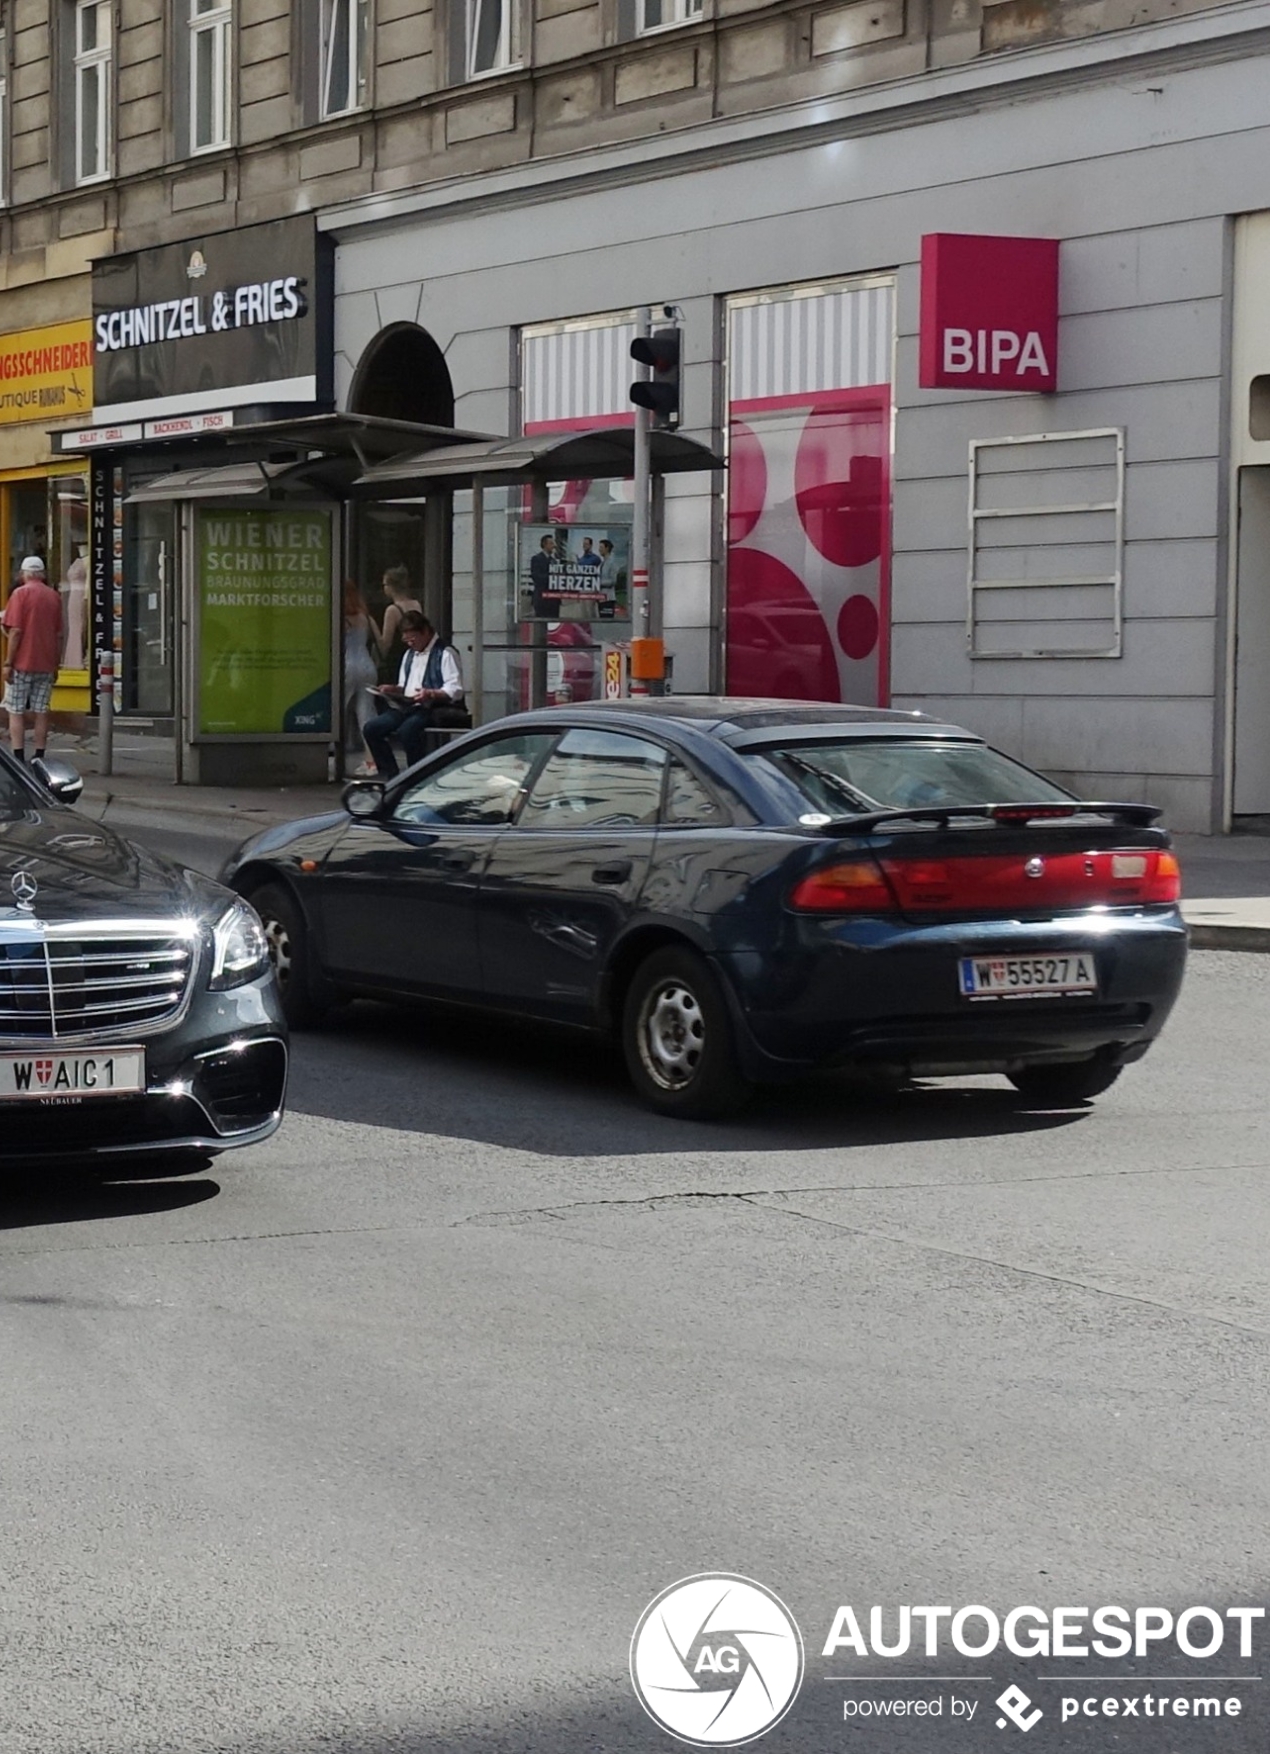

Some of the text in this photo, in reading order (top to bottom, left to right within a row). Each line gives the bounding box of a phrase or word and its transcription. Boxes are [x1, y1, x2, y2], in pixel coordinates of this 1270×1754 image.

[96, 276, 299, 352] SCHNITZEL & FRIES
[943, 328, 1049, 376] BIPA
[203, 415, 223, 426] FISCH
[105, 429, 123, 440] GRILL
[94, 470, 105, 606] SCHNITZEL
[207, 523, 323, 549] WIENER
[207, 552, 324, 571] SCHNITZEL
[549, 563, 564, 574] MIT
[206, 573, 325, 589] BRÄUNUNGSGRAD
[549, 575, 600, 591] HERZEN
[207, 593, 324, 606] MARKTFORSCHER
[294, 715, 316, 725] XING
[976, 964, 991, 987] W
[13, 1062, 33, 1090] W
